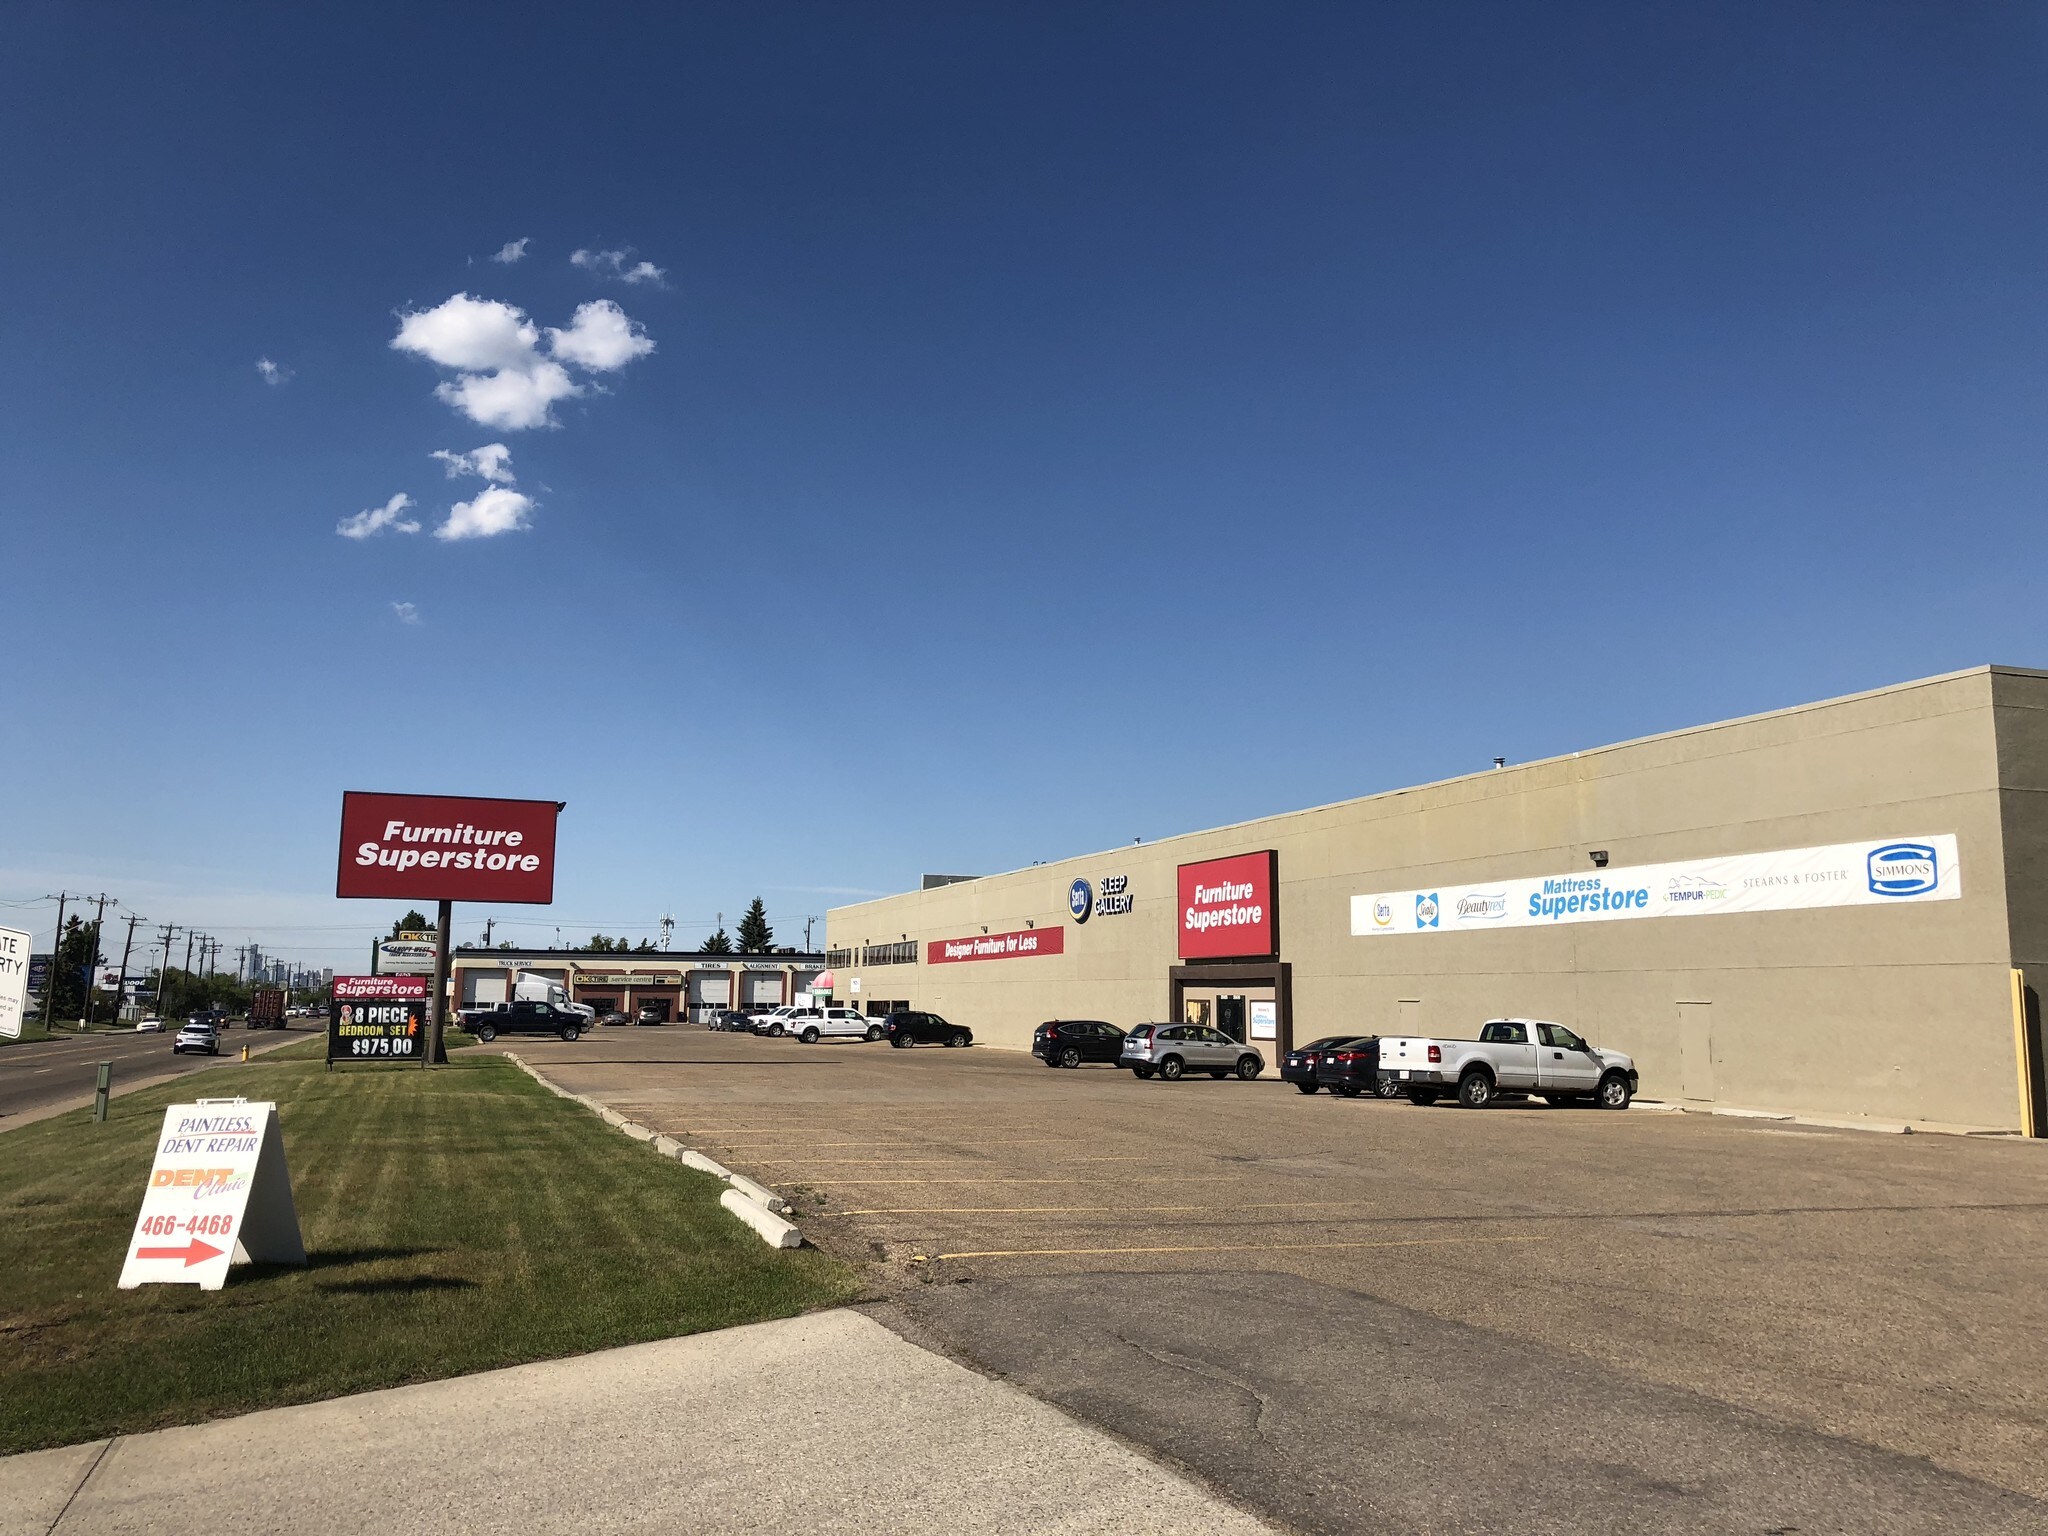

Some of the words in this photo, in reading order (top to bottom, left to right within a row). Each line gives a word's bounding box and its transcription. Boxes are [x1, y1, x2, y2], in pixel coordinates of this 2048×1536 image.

[383, 821, 523, 847] Furniture
[355, 842, 540, 872] Superstore
[1743, 876, 1789, 888] STEARNS
[1805, 870, 1848, 883] FOSTER
[1875, 864, 1930, 877] SIMMONS
[1100, 875, 1127, 894] SLEEP
[1194, 880, 1253, 905] Furniture
[1543, 878, 1601, 895] Mattress
[1071, 888, 1085, 907] Serta
[1095, 895, 1133, 915] GALLERY
[1456, 897, 1507, 916] Beautyrest
[1528, 887, 1649, 920] Superstore
[1185, 904, 1262, 932] Superstore
[1377, 904, 1390, 917] Serta
[0, 936, 18, 954] TE
[401, 932, 420, 941] OK
[945, 942, 973, 959] Designer
[974, 938, 1005, 955] Furniture
[1006, 935, 1018, 952] for
[1018, 934, 1038, 951] Less
[576, 976, 590, 984] OK
[336, 983, 423, 996] Superstore
[355, 1007, 364, 1023] 8
[368, 1007, 408, 1023] PIECE
[339, 1025, 384, 1036] BEDROOM
[390, 1025, 407, 1036] SET
[352, 1038, 413, 1056] $975.00
[177, 1116, 253, 1133] PAINTLESS
[162, 1139, 205, 1154] DENT
[206, 1137, 258, 1153] REPAIR
[152, 1168, 234, 1187] DENT
[193, 1177, 249, 1200] Clinic
[141, 1215, 233, 1236] 466-4468
